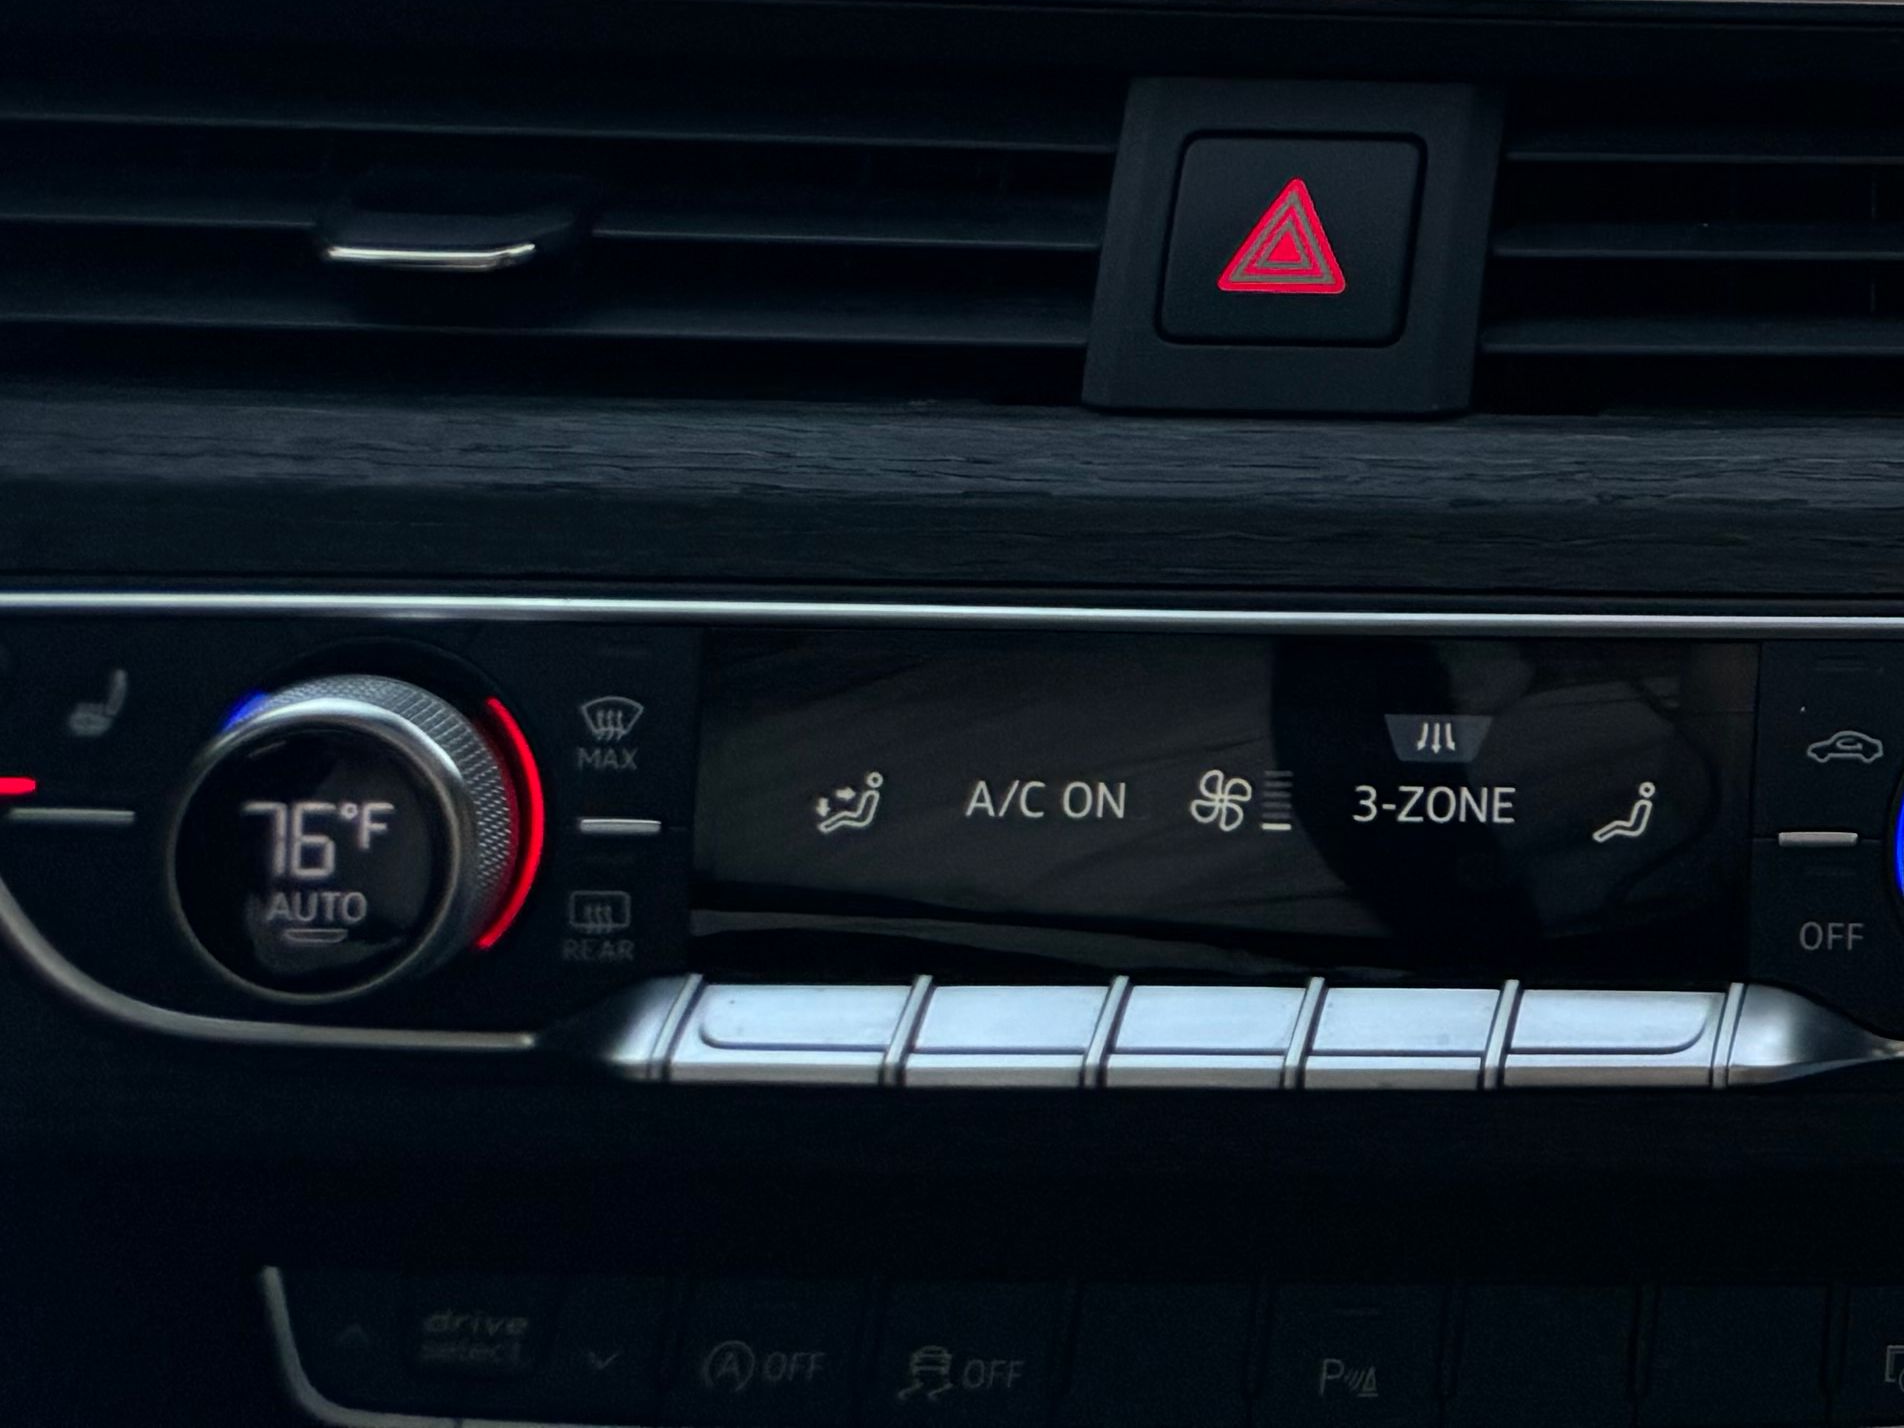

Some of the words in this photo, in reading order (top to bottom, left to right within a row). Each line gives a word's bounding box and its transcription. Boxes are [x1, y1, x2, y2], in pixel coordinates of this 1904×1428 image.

[577, 748, 638, 771] MAX
[965, 782, 1046, 818] A/C
[1062, 782, 1126, 818] ON
[1353, 786, 1516, 824] 3-ZONE
[267, 892, 368, 925] AUTO
[1800, 922, 1864, 952] OFF
[763, 1350, 825, 1380] OFF
[962, 1357, 1025, 1388] OFF
